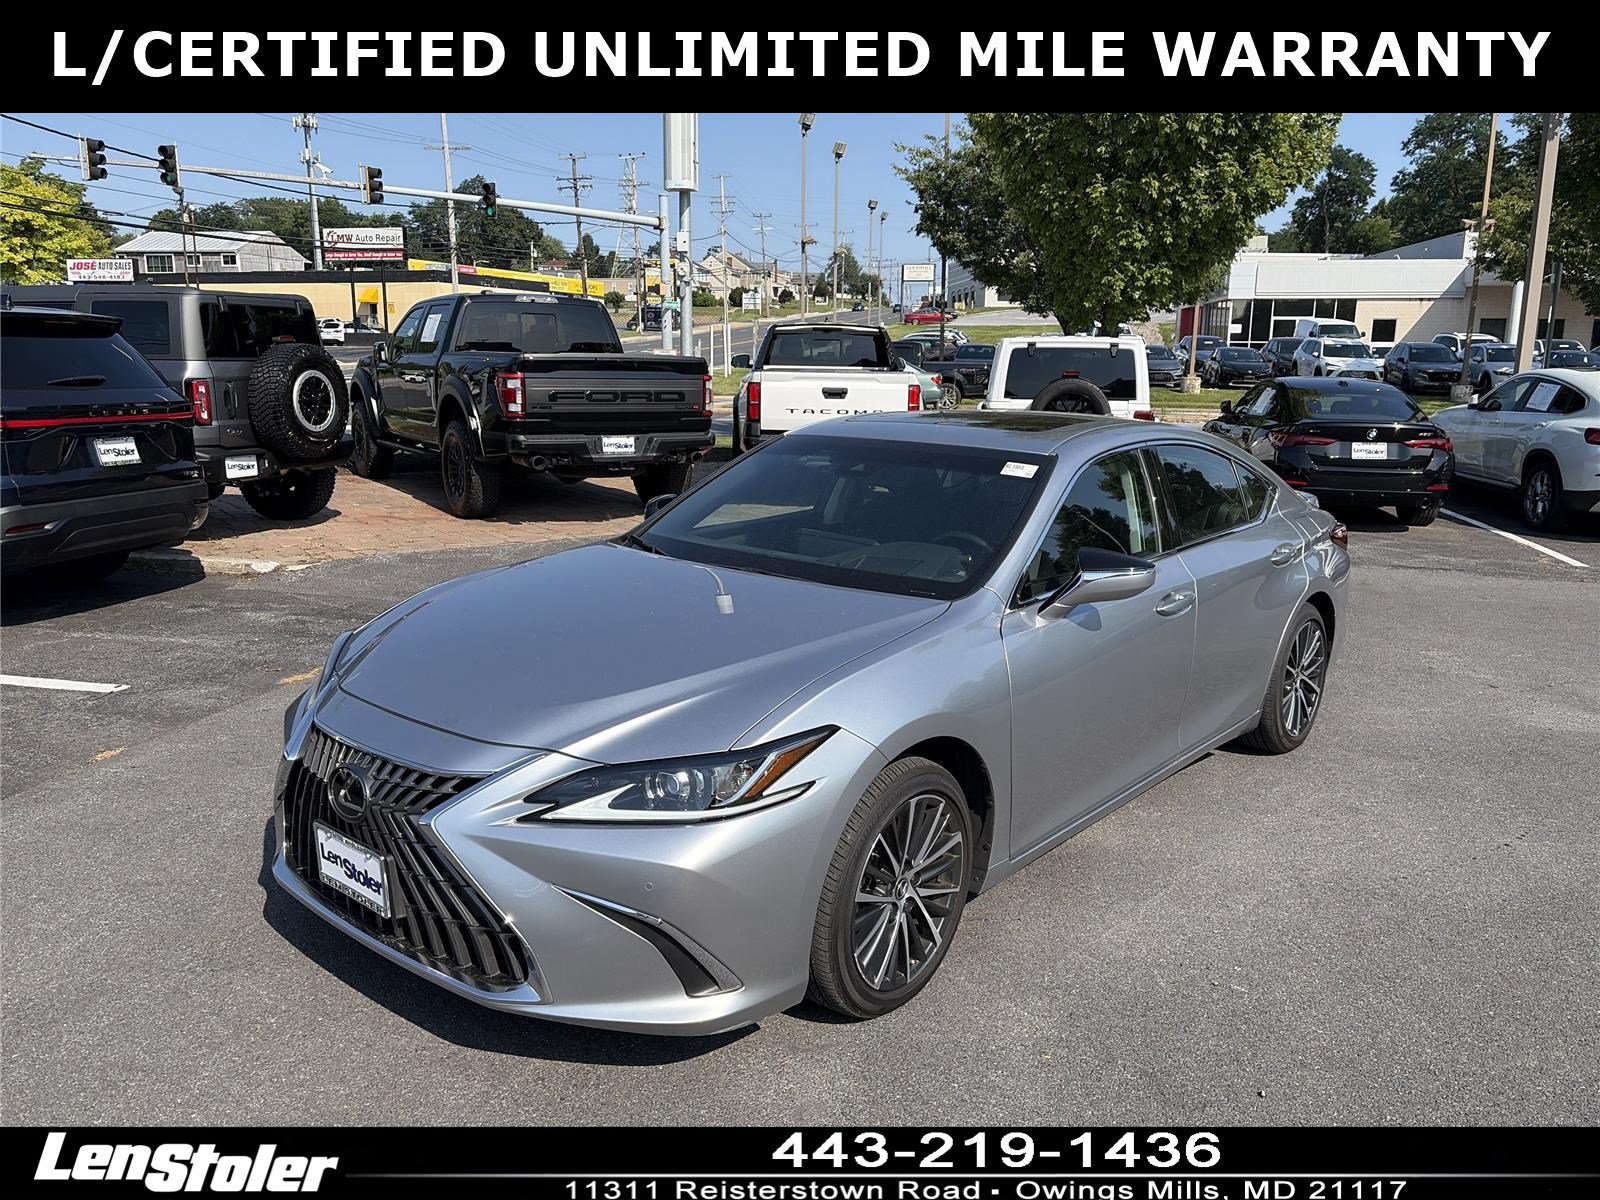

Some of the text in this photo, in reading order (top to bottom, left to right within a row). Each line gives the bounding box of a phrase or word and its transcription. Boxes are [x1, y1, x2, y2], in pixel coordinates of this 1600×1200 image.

[355, 234, 373, 242] Auto
[375, 234, 401, 244] Repair
[69, 260, 132, 270] JOSÉ AUTO SALES
[548, 390, 685, 402] FORD
